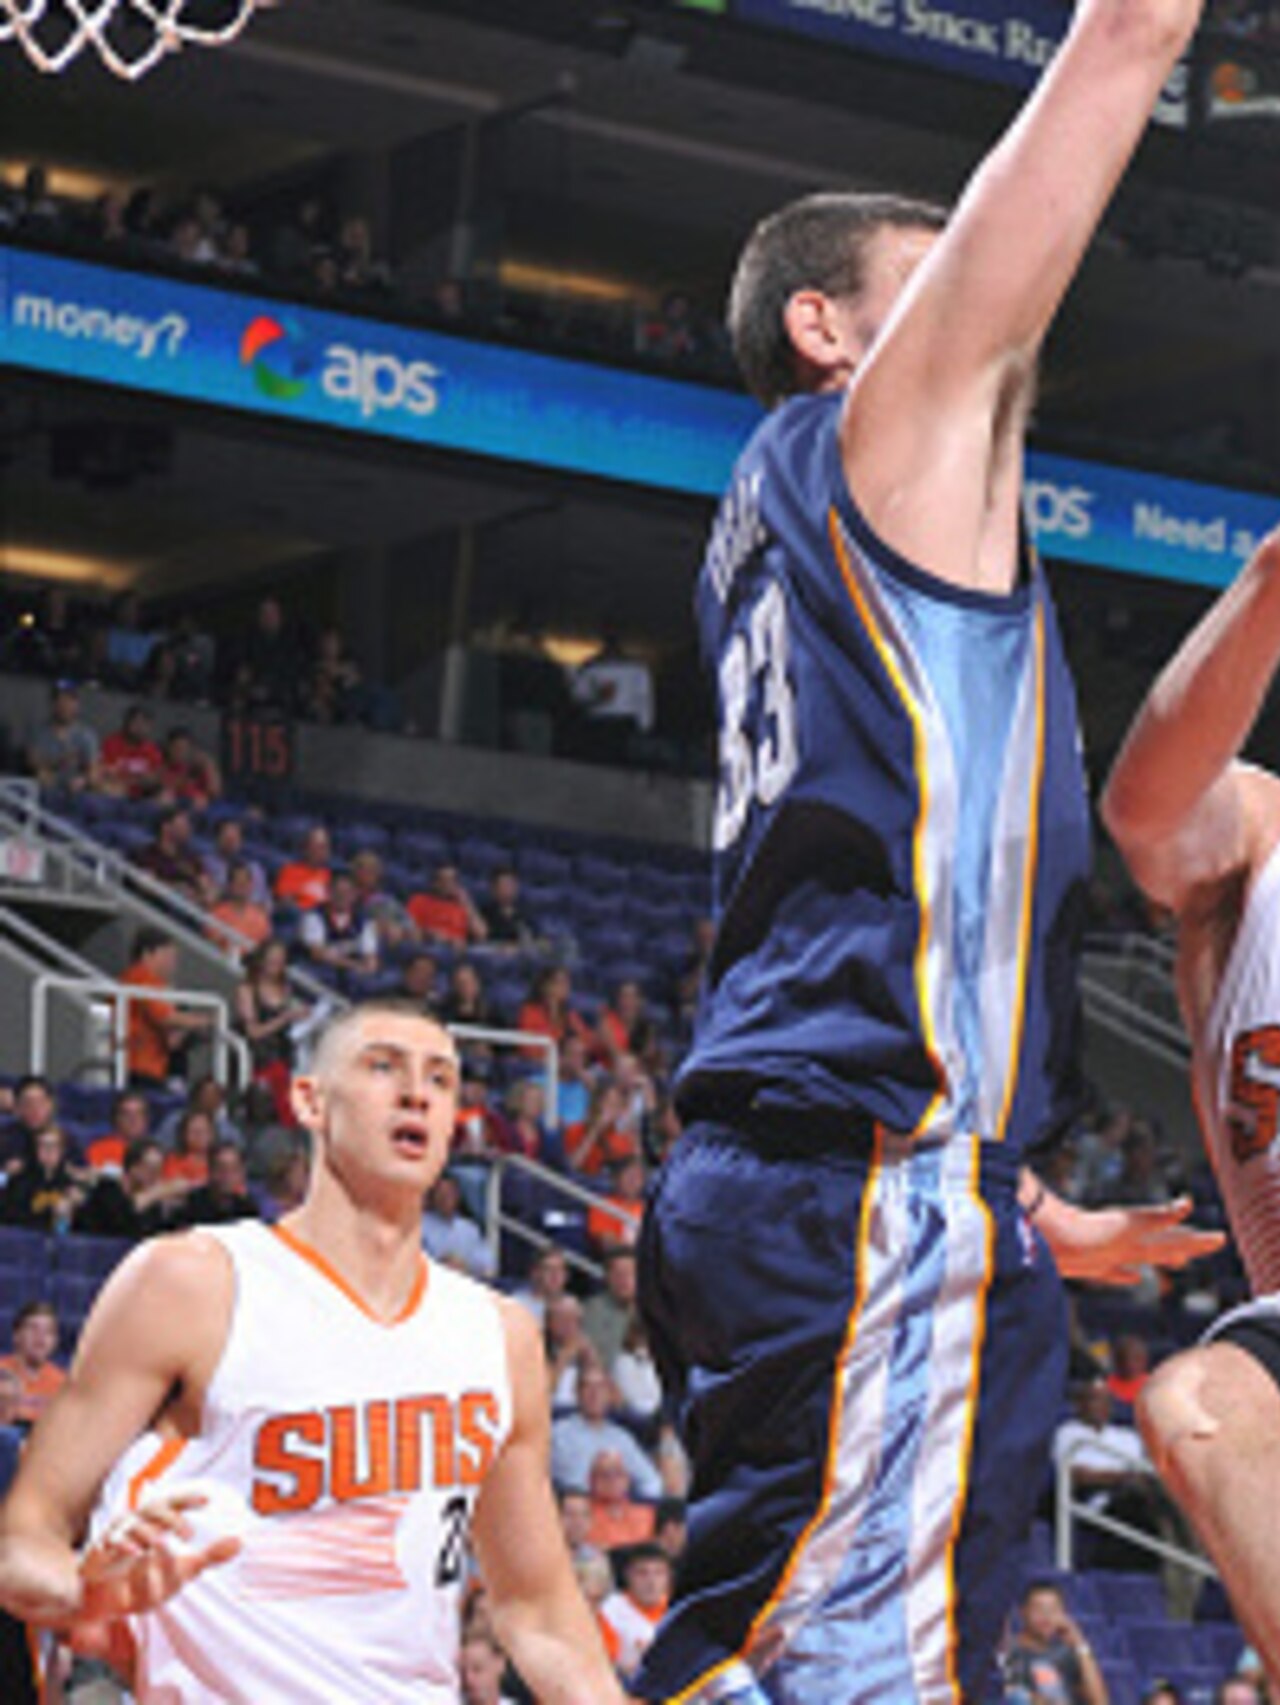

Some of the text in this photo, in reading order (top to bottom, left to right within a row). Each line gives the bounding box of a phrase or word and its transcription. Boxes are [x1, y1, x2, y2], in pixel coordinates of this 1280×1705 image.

[14, 294, 189, 358] money?
[322, 344, 440, 418] aps
[1024, 480, 1094, 538] ps
[1133, 502, 1226, 553] Need
[231, 722, 289, 774] 115
[713, 580, 798, 850] 33
[251, 1389, 500, 1518] SUNS
[434, 1495, 470, 1590] 2
